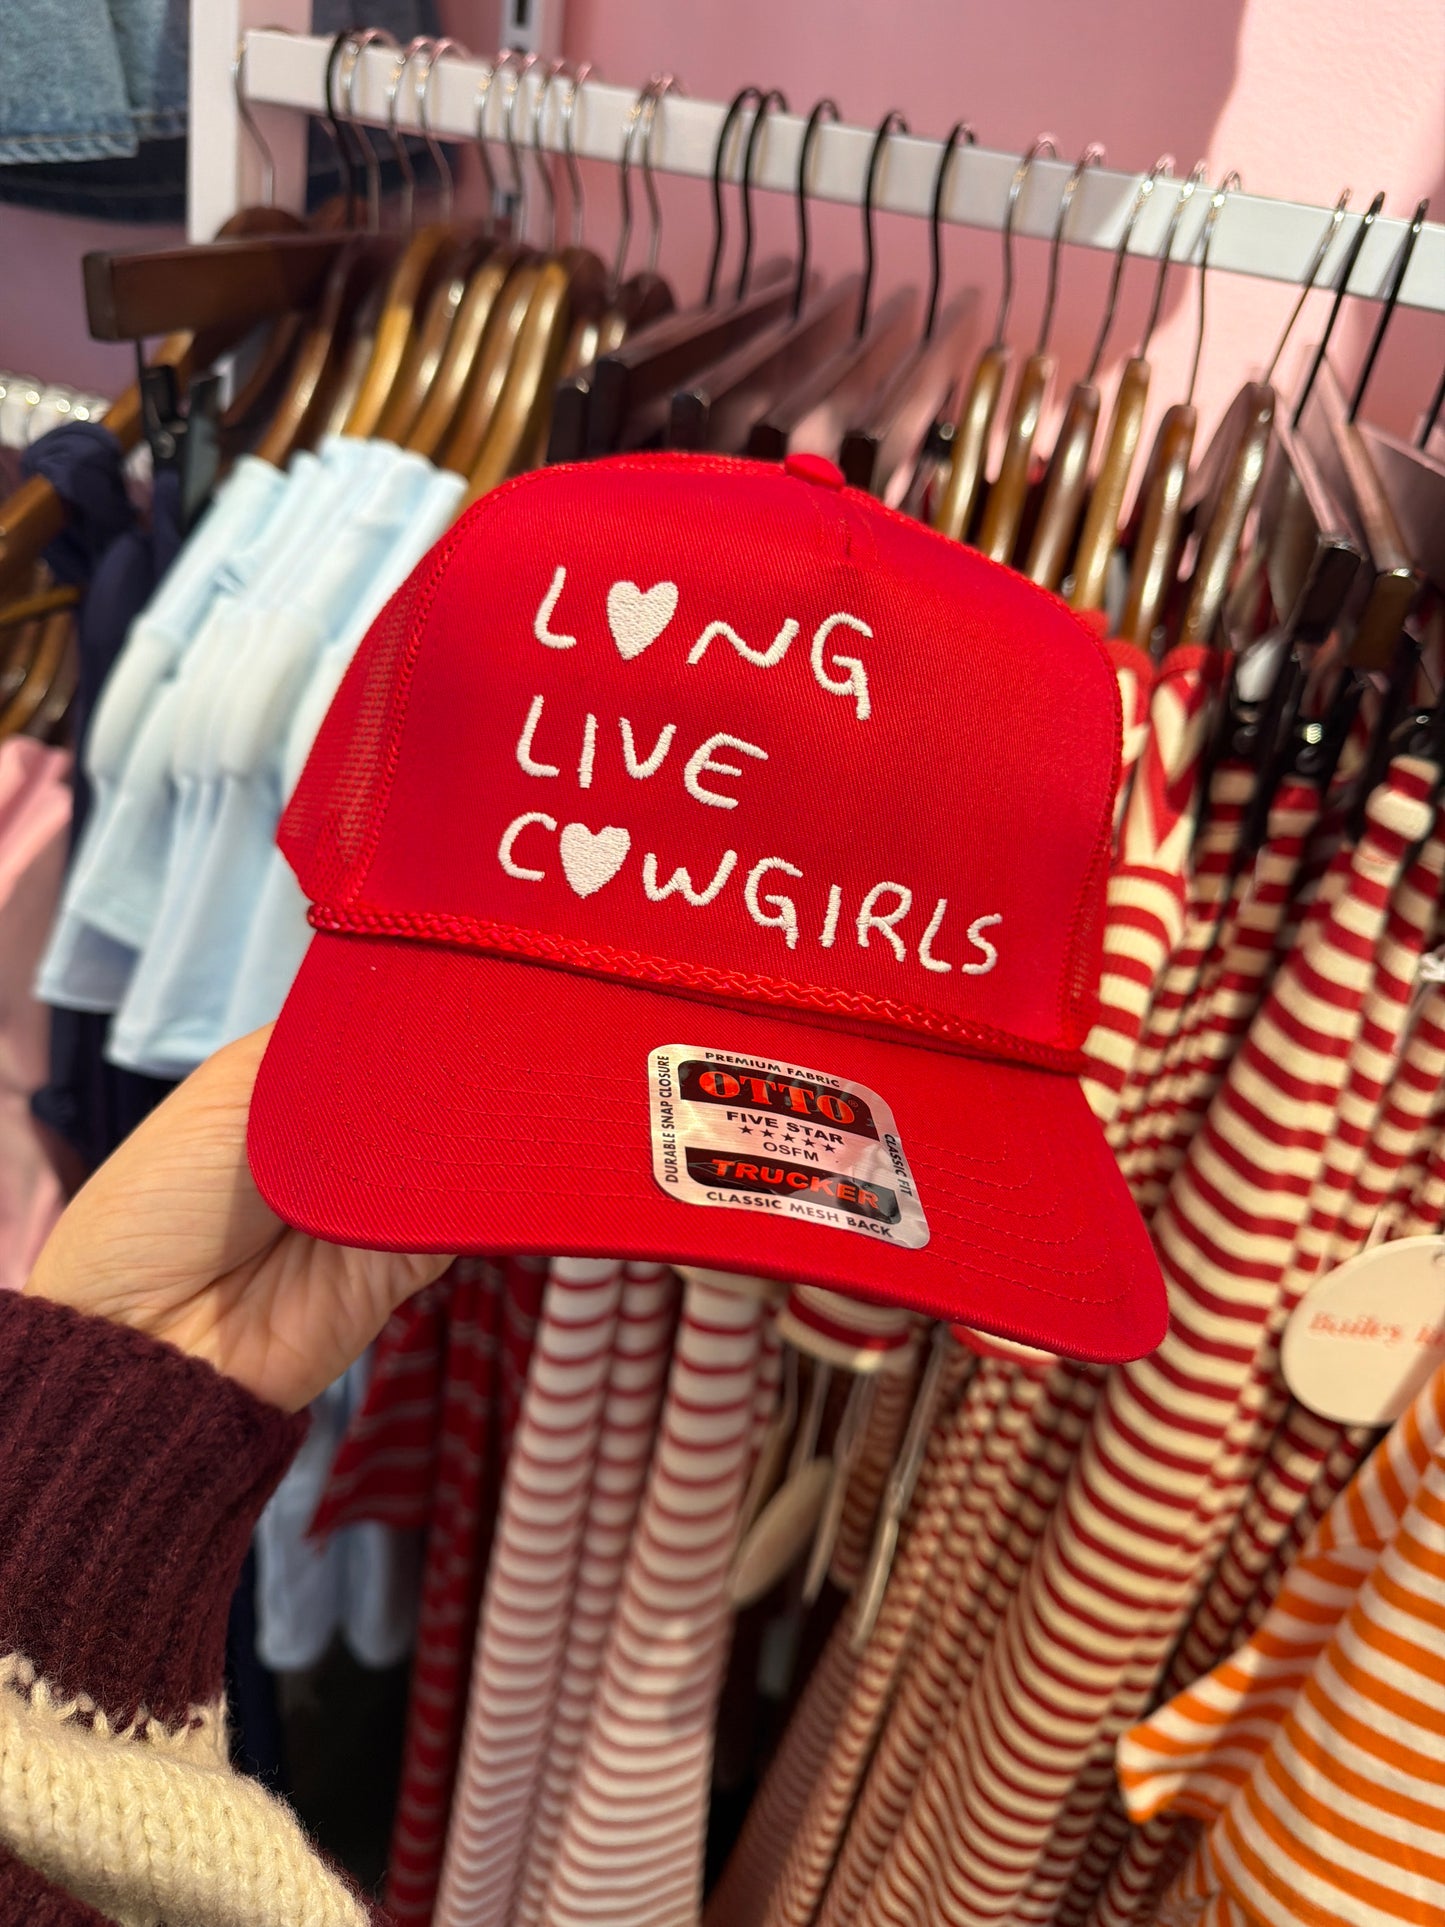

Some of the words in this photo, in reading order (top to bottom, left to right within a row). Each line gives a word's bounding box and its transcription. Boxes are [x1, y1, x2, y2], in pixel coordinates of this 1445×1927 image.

[516, 695, 769, 810] LIVE
[657, 1055, 673, 1098] CLOSURE
[705, 1052, 781, 1072] PREMIUM
[787, 1067, 839, 1087] FABRIC
[661, 1101, 675, 1131] SNAP
[726, 1111, 778, 1128] FIVE
[787, 1123, 845, 1144] STAR
[663, 1132, 679, 1183] DURABLE
[763, 1142, 819, 1162] OSFM
[884, 1134, 908, 1178] CLASSIC
[896, 1178, 913, 1197] FIT
[711, 1159, 879, 1209] TRUCKER
[707, 1192, 782, 1210] CLASSIC
[789, 1203, 839, 1223] MESH
[846, 1217, 893, 1238] BACK
